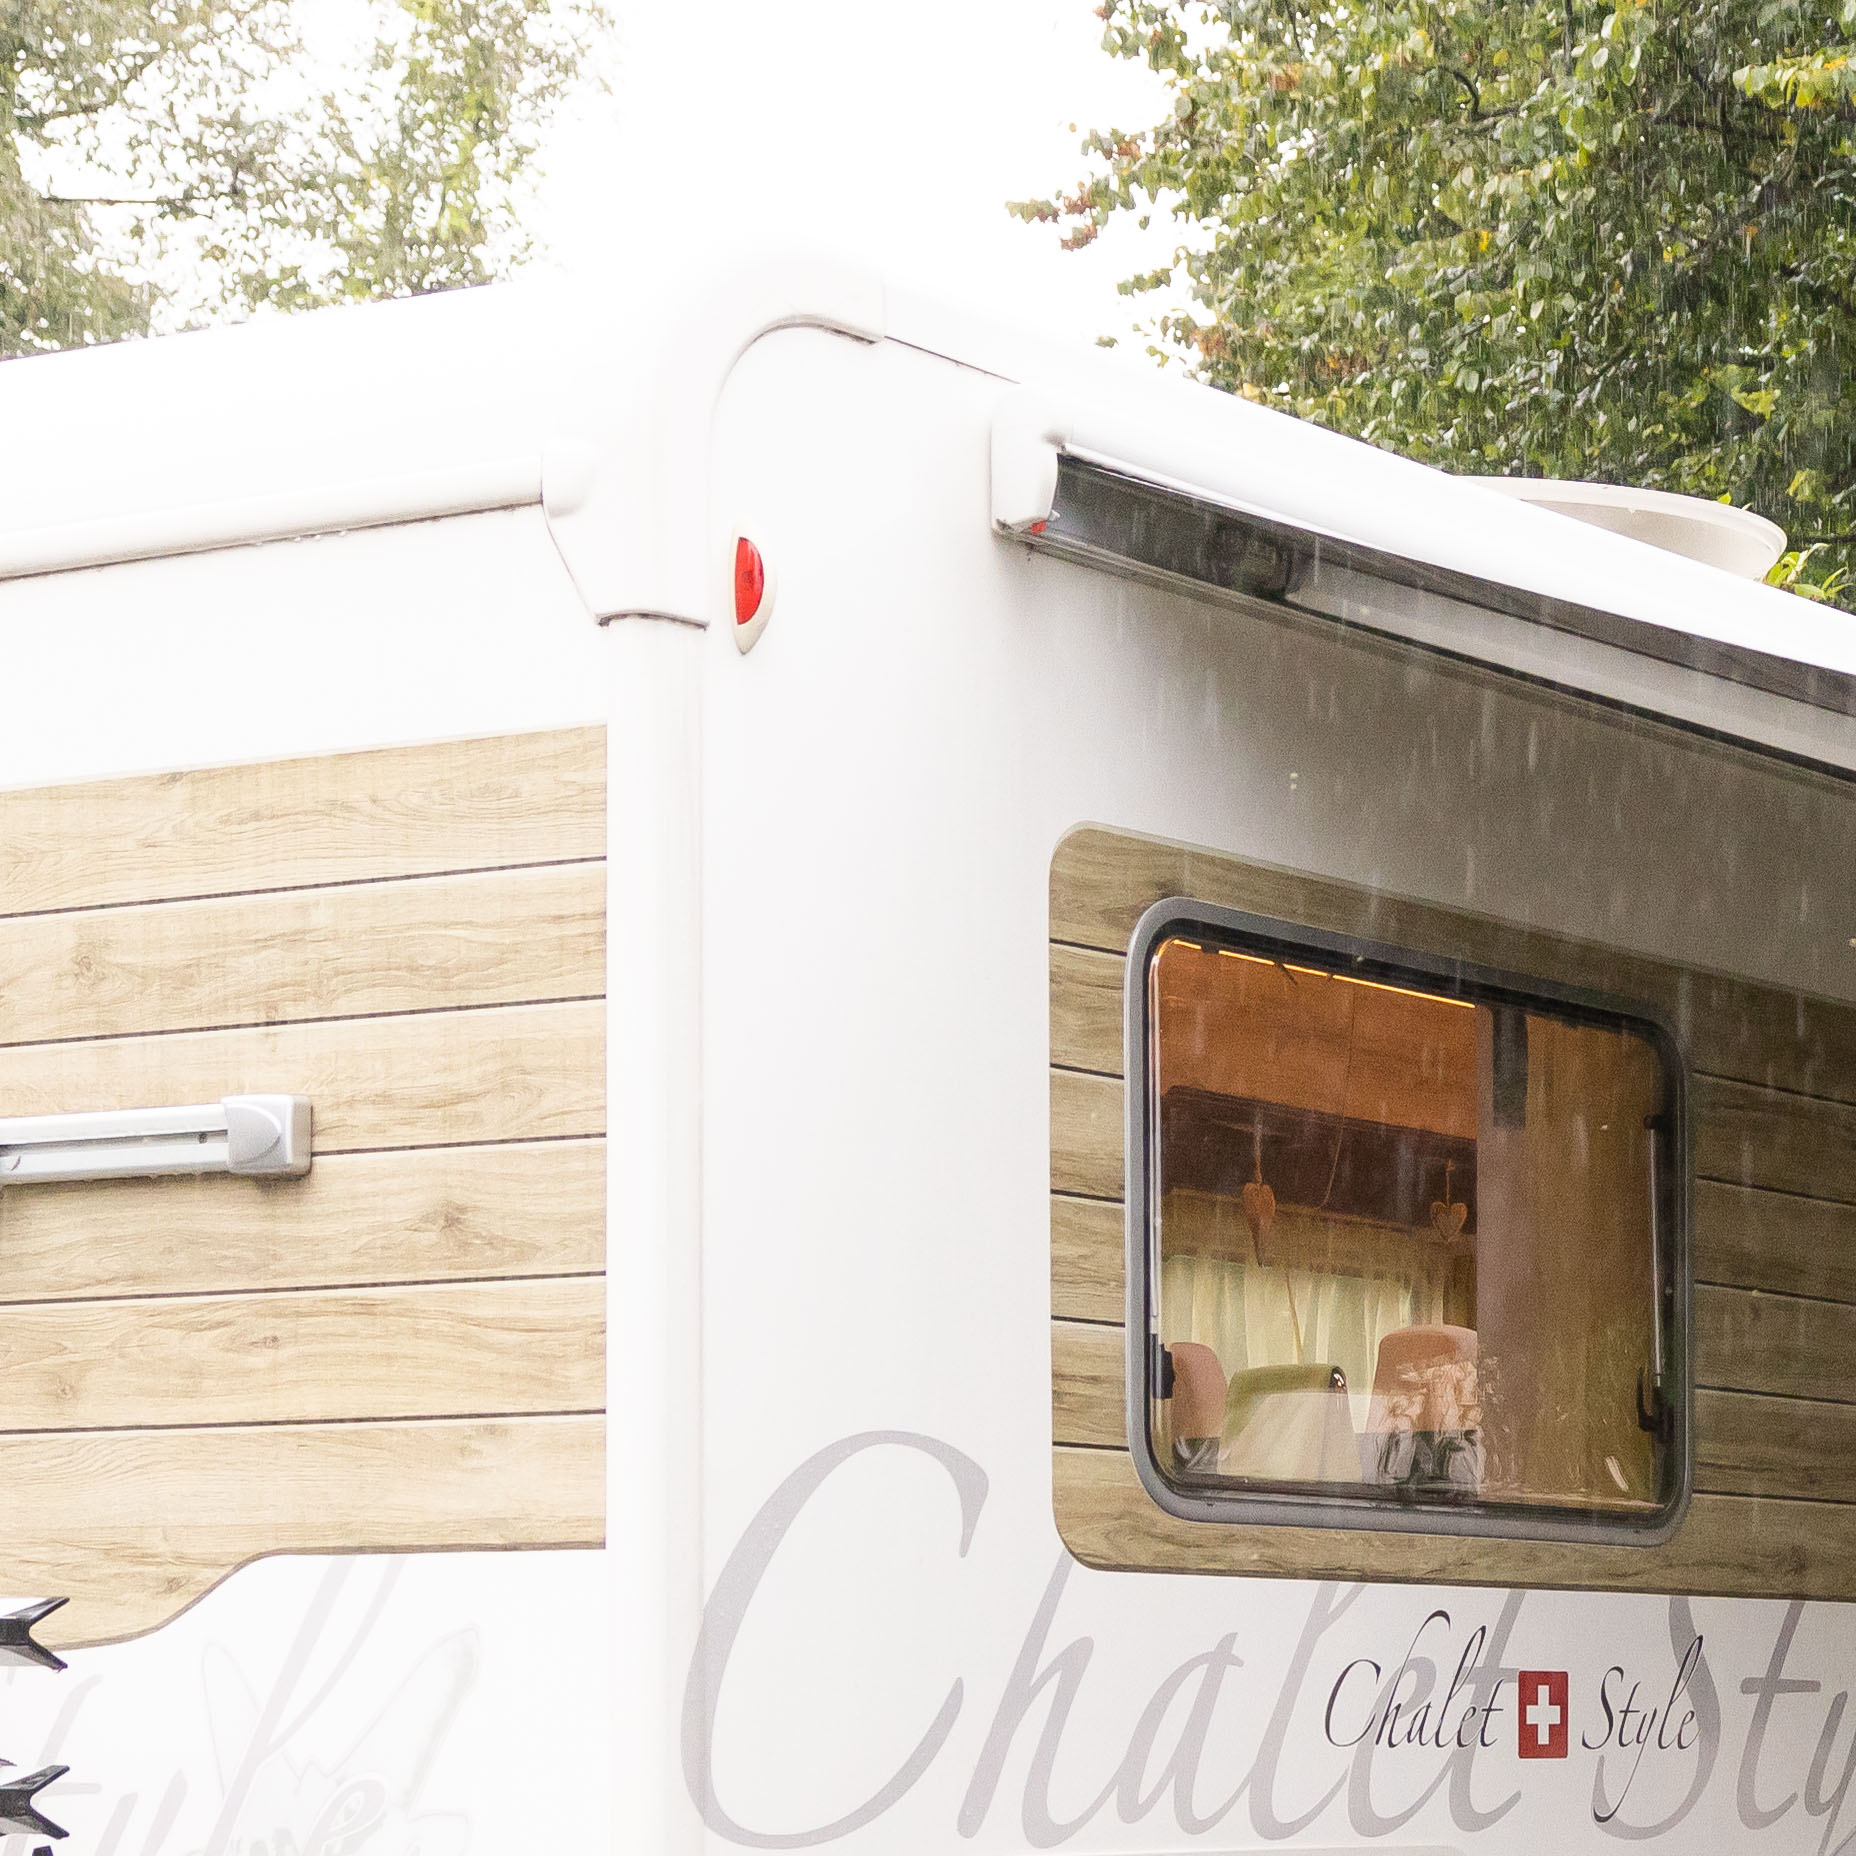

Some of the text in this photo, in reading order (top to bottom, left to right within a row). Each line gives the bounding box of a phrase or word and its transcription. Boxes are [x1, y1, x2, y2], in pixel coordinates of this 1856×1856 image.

[680, 1429, 1527, 1849] Chalet
[1325, 1609, 1704, 1823] Chalet Style
